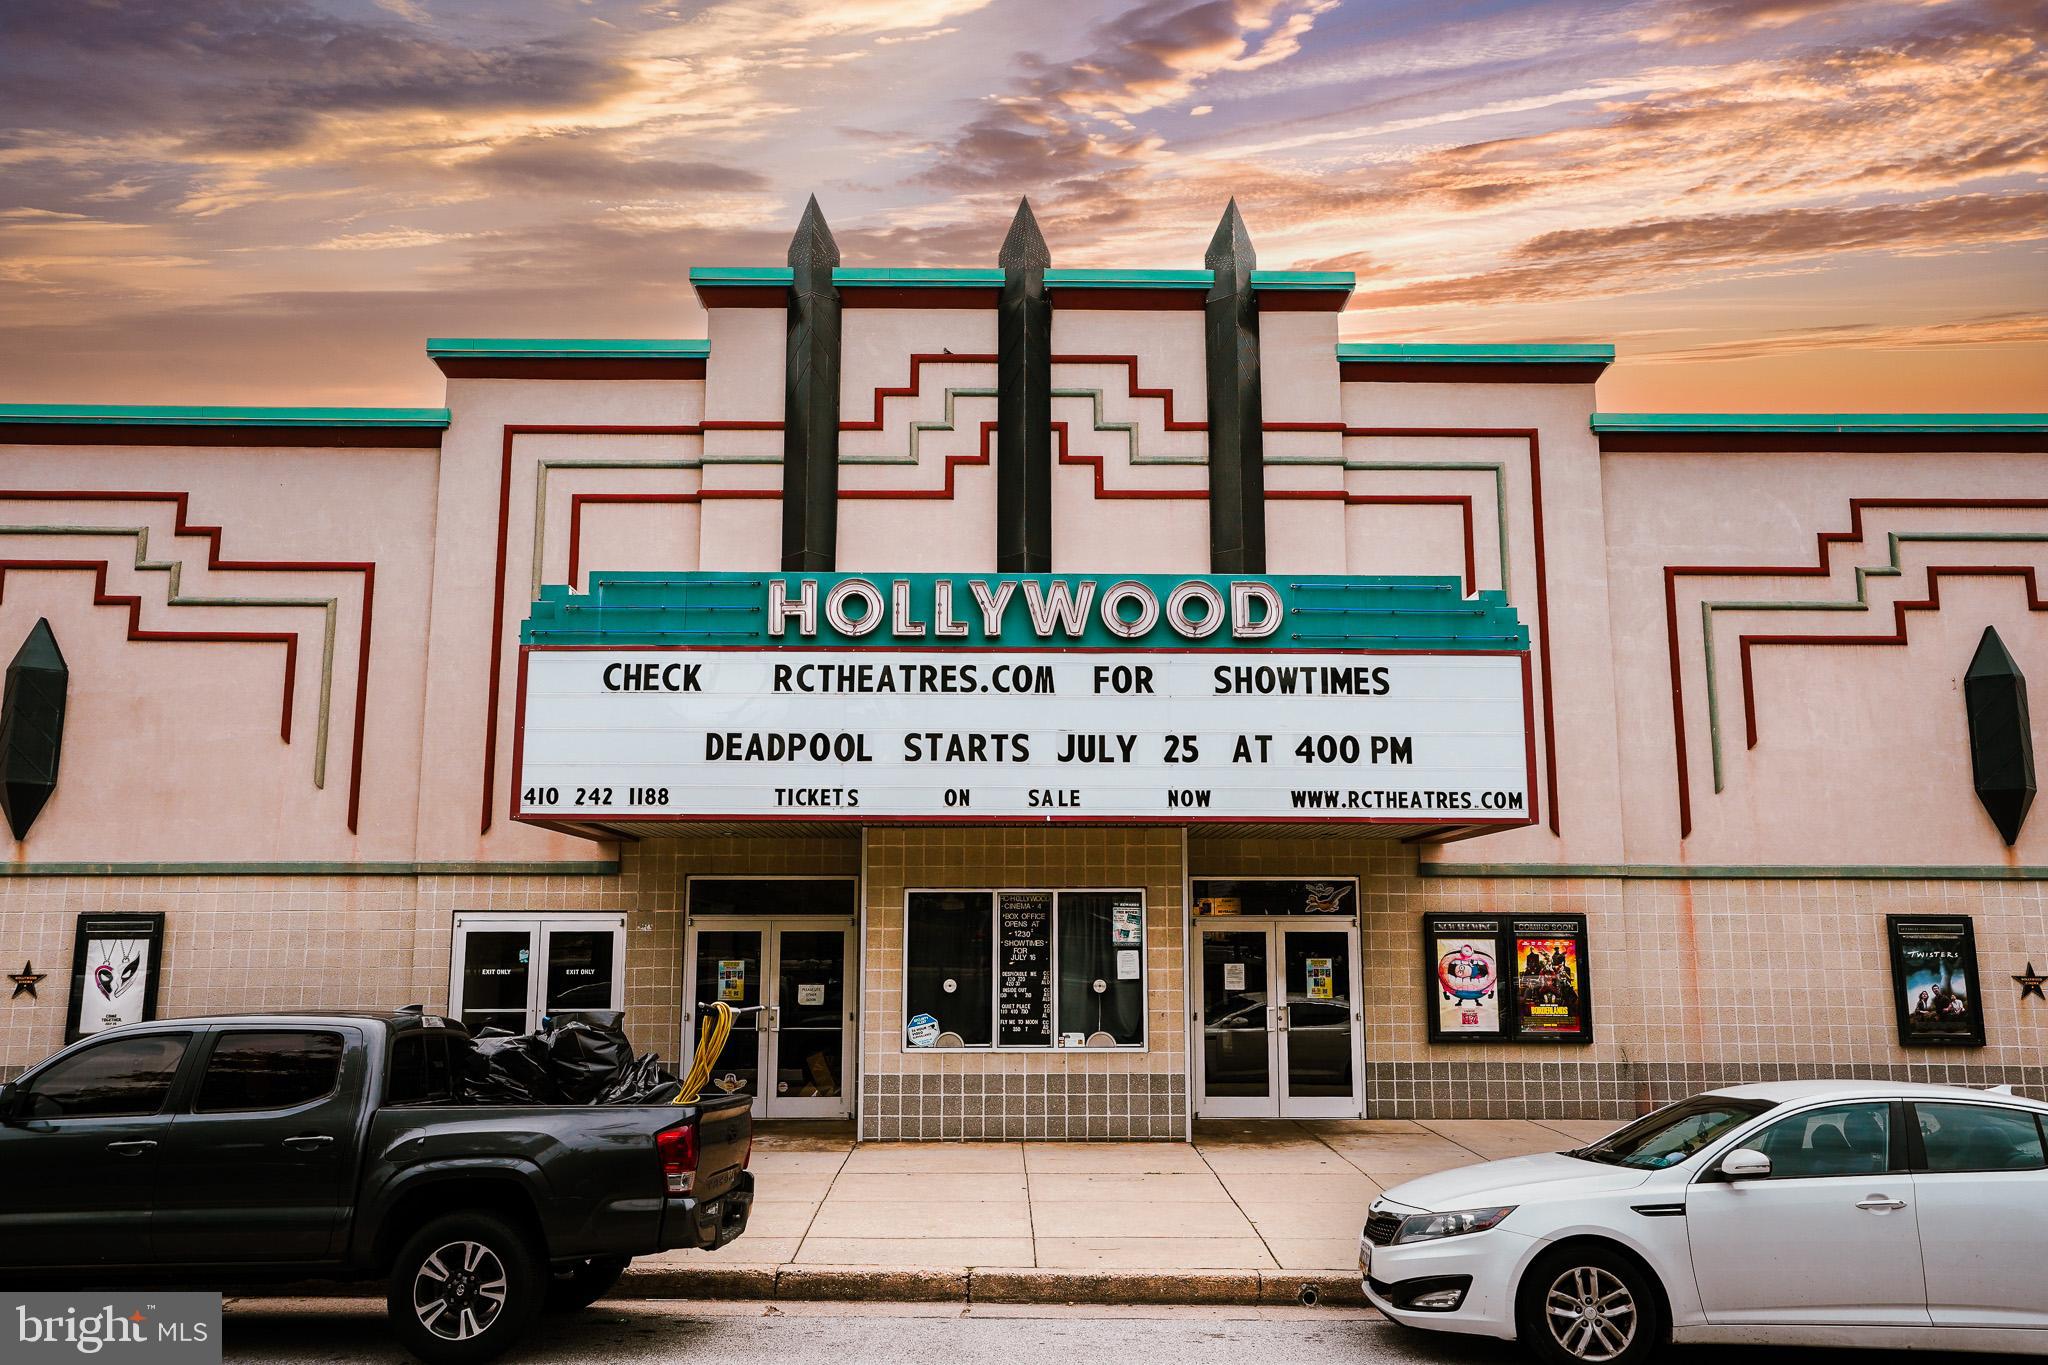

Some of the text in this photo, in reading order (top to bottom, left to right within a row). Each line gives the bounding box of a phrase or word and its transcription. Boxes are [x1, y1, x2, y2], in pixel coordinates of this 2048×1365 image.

[767, 578, 1284, 639] HOLLYWOOD
[602, 663, 1390, 695] CHECK RCTHEATRES.COM FOR SHOWTIMES
[705, 732, 1413, 764] DEADPOOL STARTS JULY 25 AT 400 PM
[523, 787, 1523, 809] 410 242 1188 TICKETS ON SALE NOW WWW.RCTHEATRES.COM
